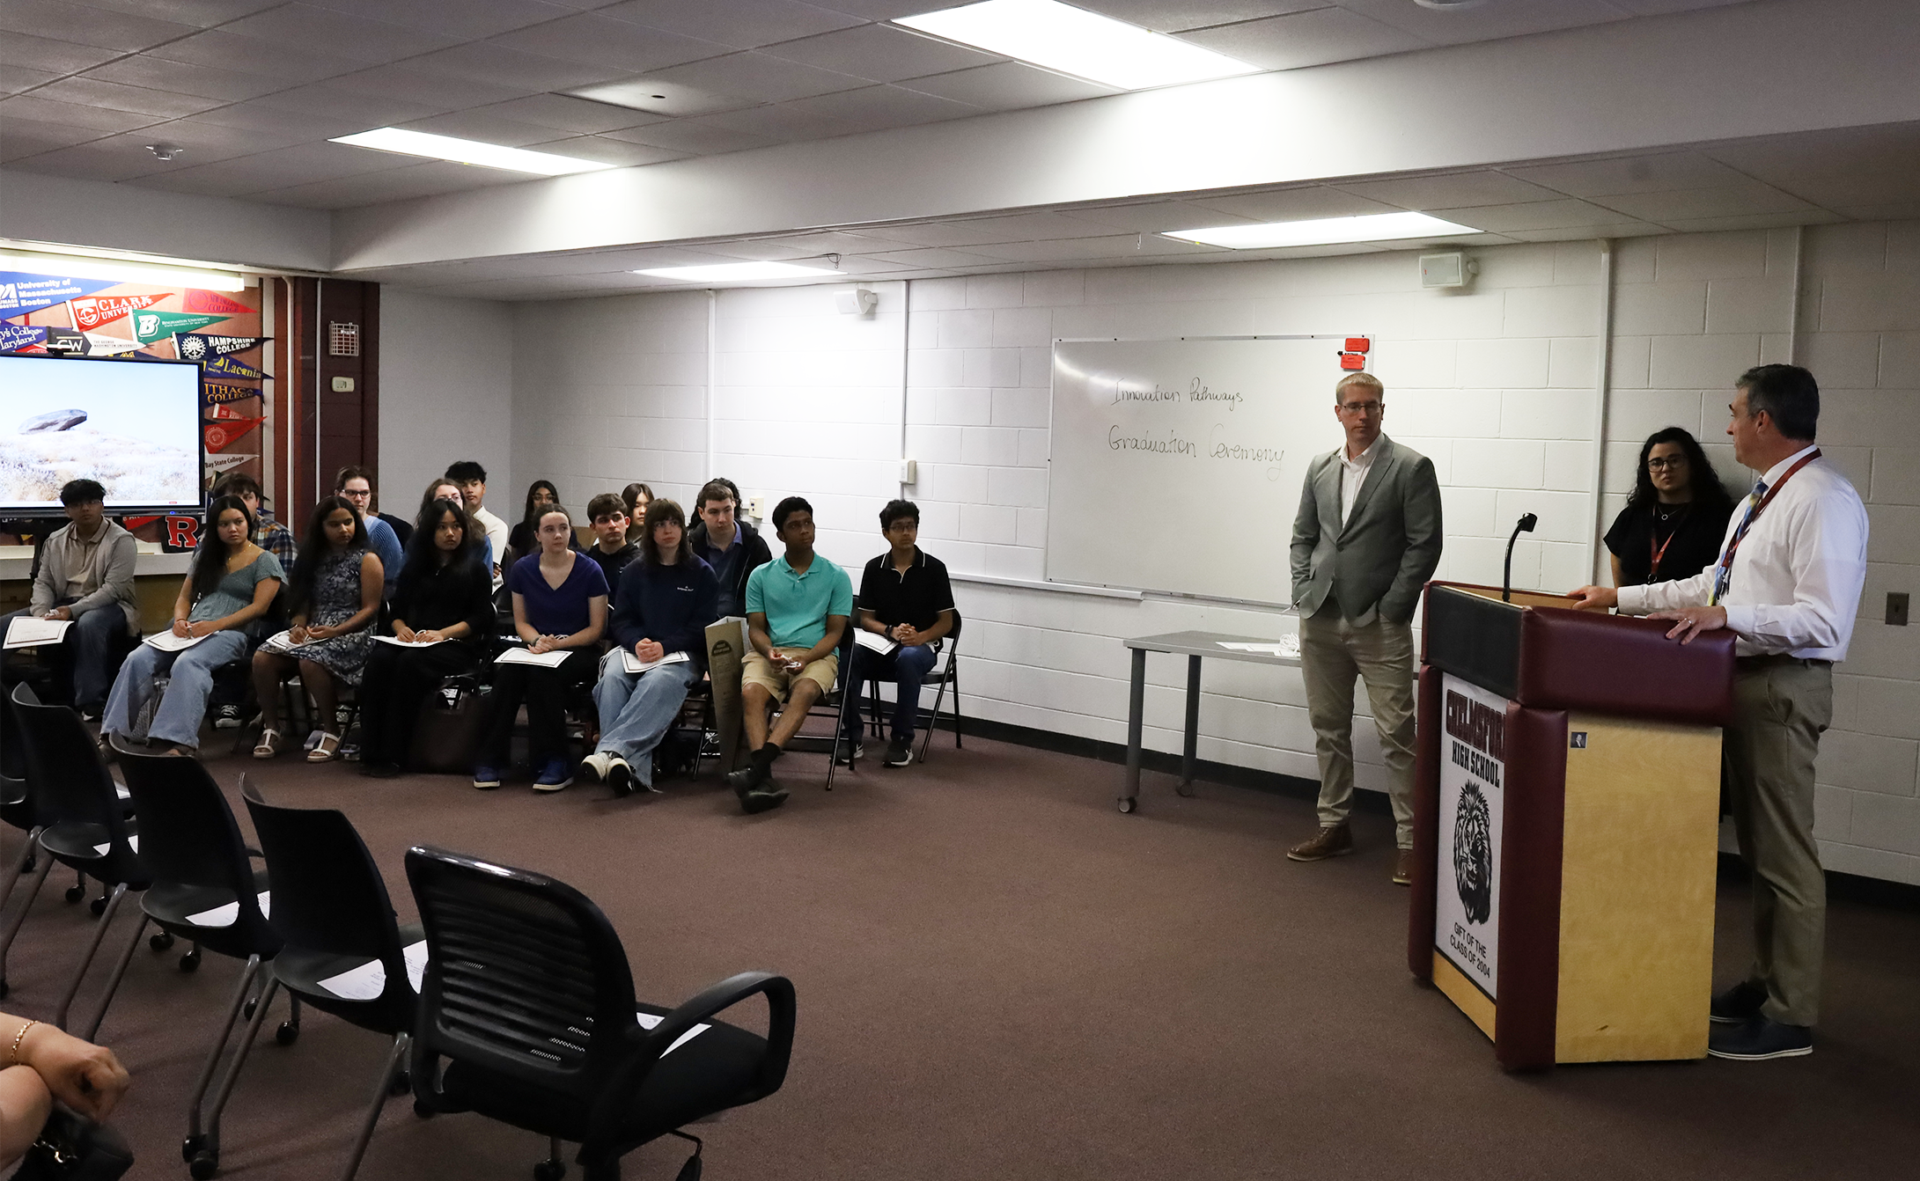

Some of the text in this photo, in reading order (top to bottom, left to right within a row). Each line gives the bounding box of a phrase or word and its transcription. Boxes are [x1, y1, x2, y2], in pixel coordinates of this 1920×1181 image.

[17, 278, 71, 289] University of
[19, 287, 82, 298] Massachusetts
[20, 299, 51, 307] Boston
[98, 295, 152, 311] CLARK
[101, 300, 153, 320] UNIVESITY
[208, 336, 256, 347] HAMPSHIRE
[216, 343, 250, 354] COLLEGE
[223, 359, 261, 378] Laconia
[204, 383, 254, 396] ITHACA
[207, 392, 253, 403] COLLEGE
[1111, 376, 1244, 412] Innovation Pathways
[1108, 423, 1285, 482] Graduation Ceremony
[214, 459, 227, 467] State
[227, 456, 244, 464] College
[165, 516, 198, 547] R
[1452, 740, 1500, 789] HIGH SCHOOL
[1454, 922, 1487, 959] GIFT OF THE
[1450, 934, 1491, 979] CLASS OF 2004
